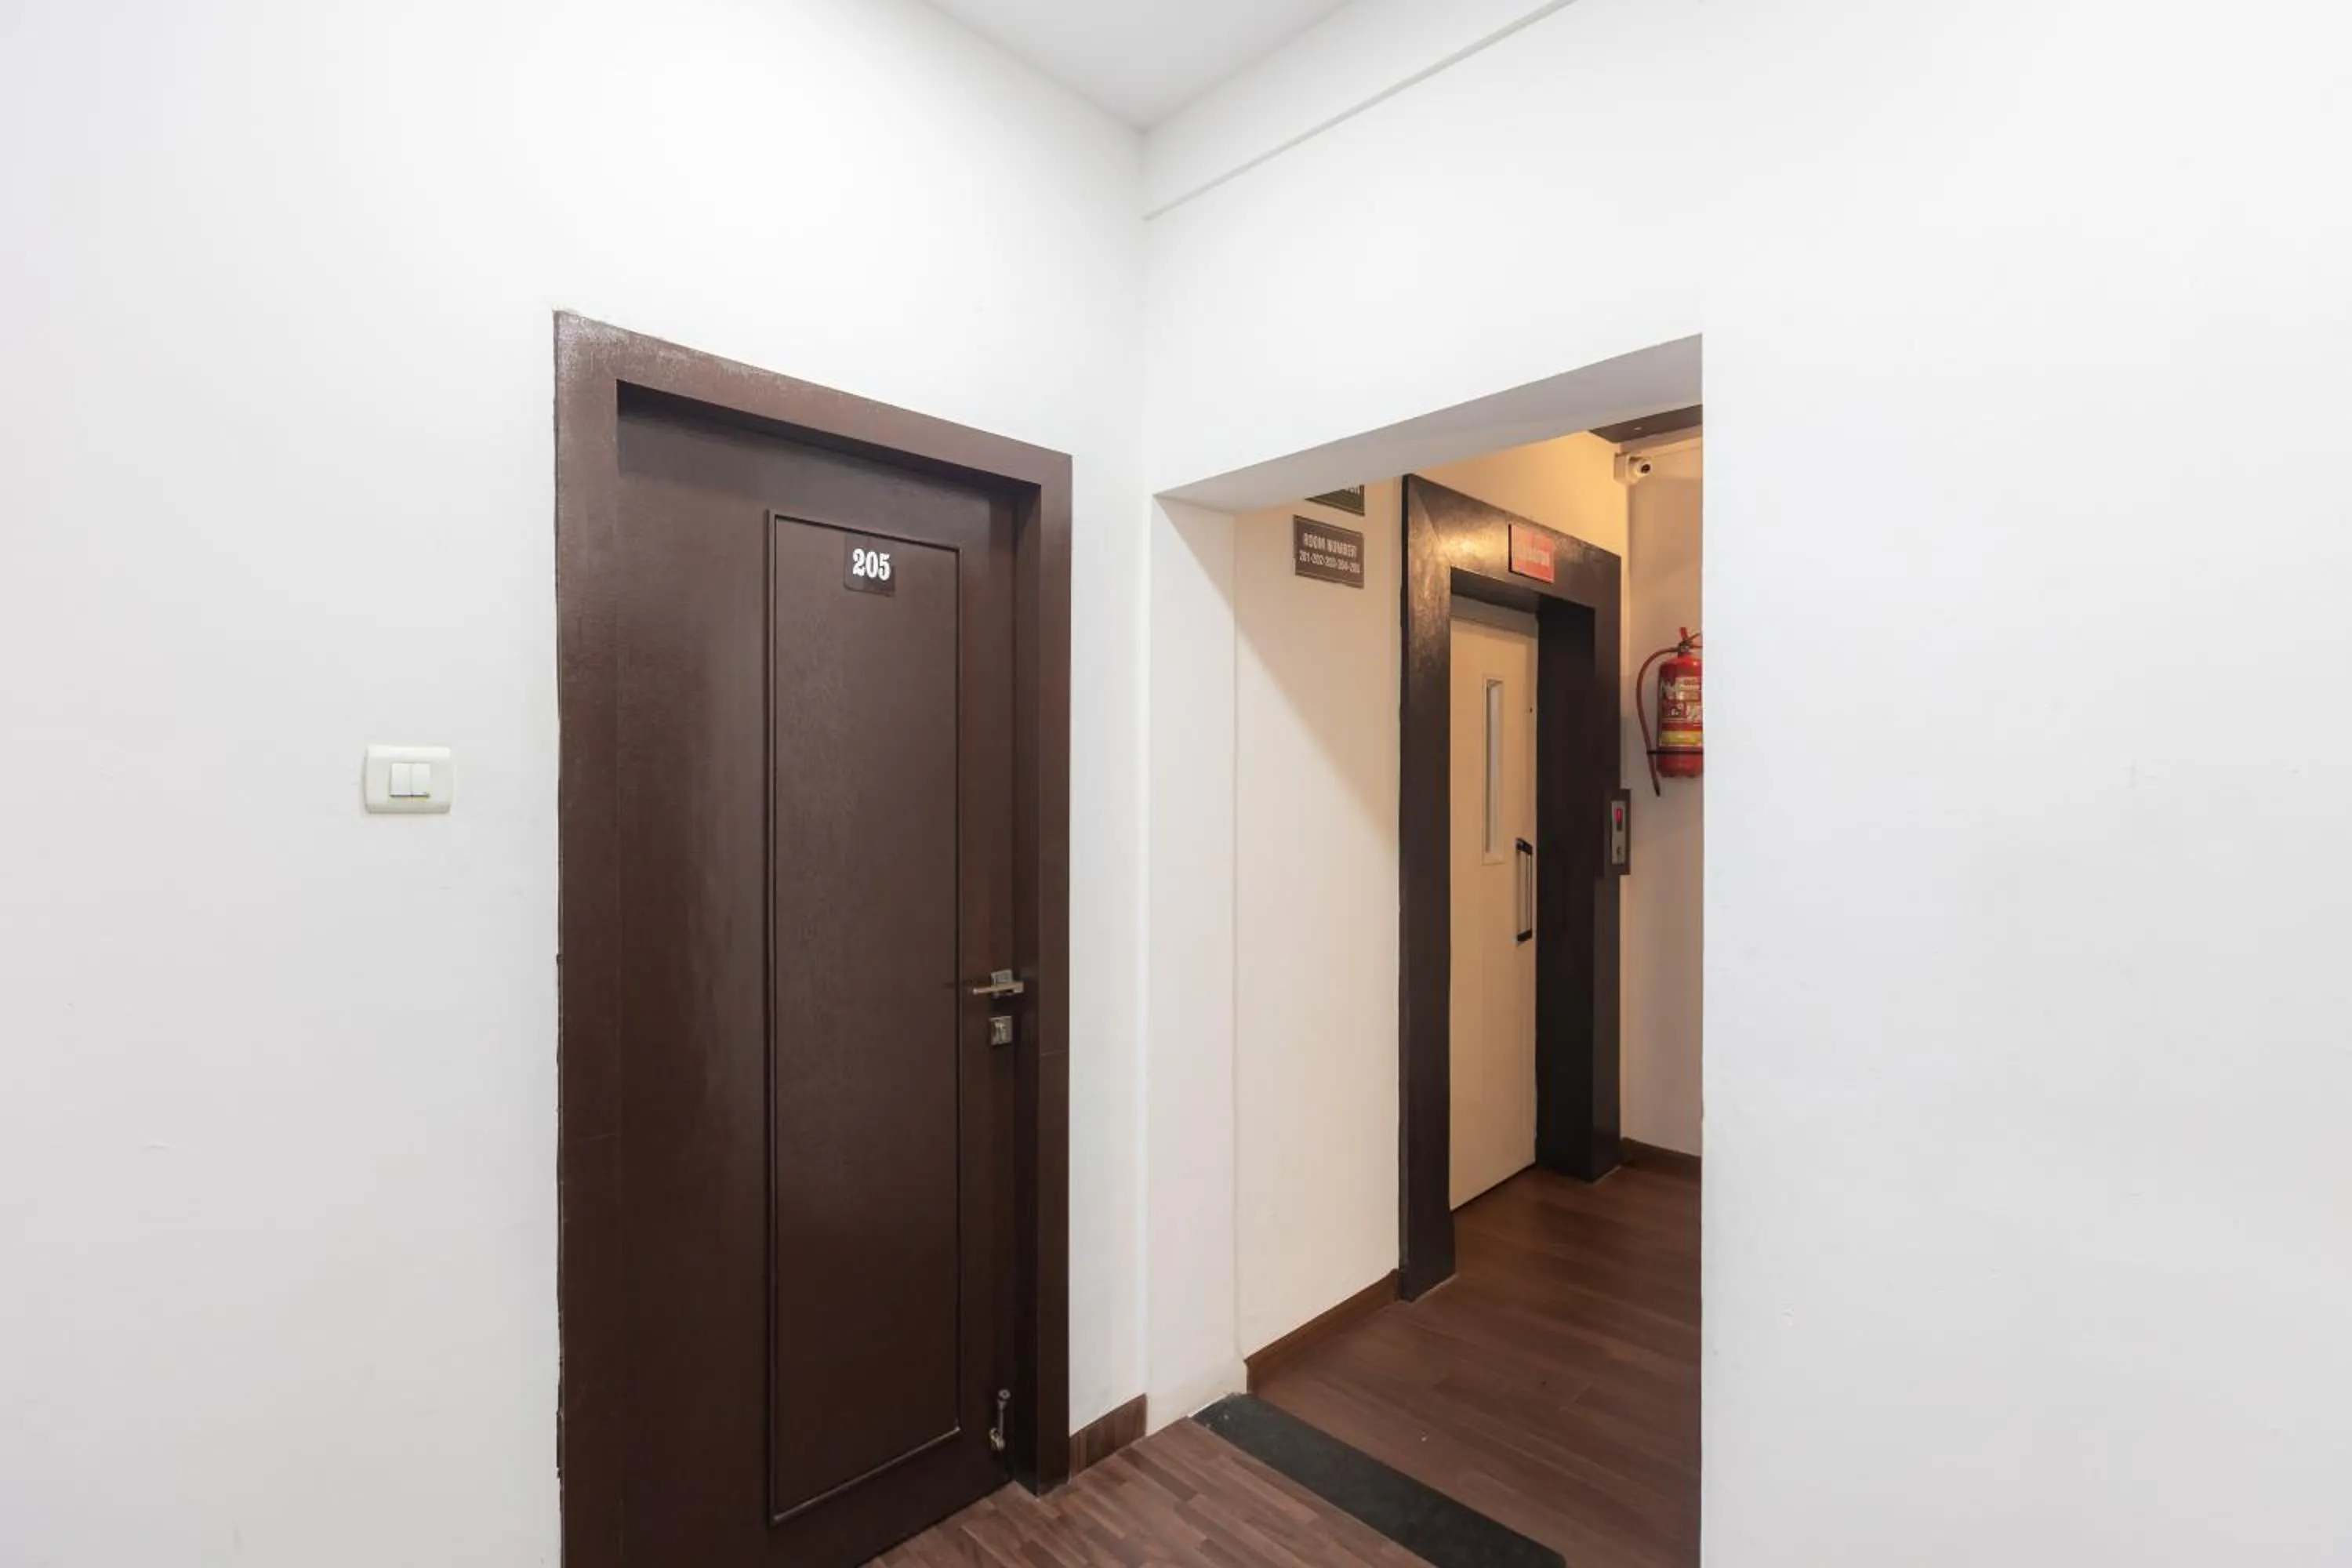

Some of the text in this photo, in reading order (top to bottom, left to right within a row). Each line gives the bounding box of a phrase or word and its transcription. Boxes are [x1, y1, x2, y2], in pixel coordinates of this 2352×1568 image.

[1303, 533, 1357, 558] ROOM NUMBER
[852, 548, 891, 581] 205
